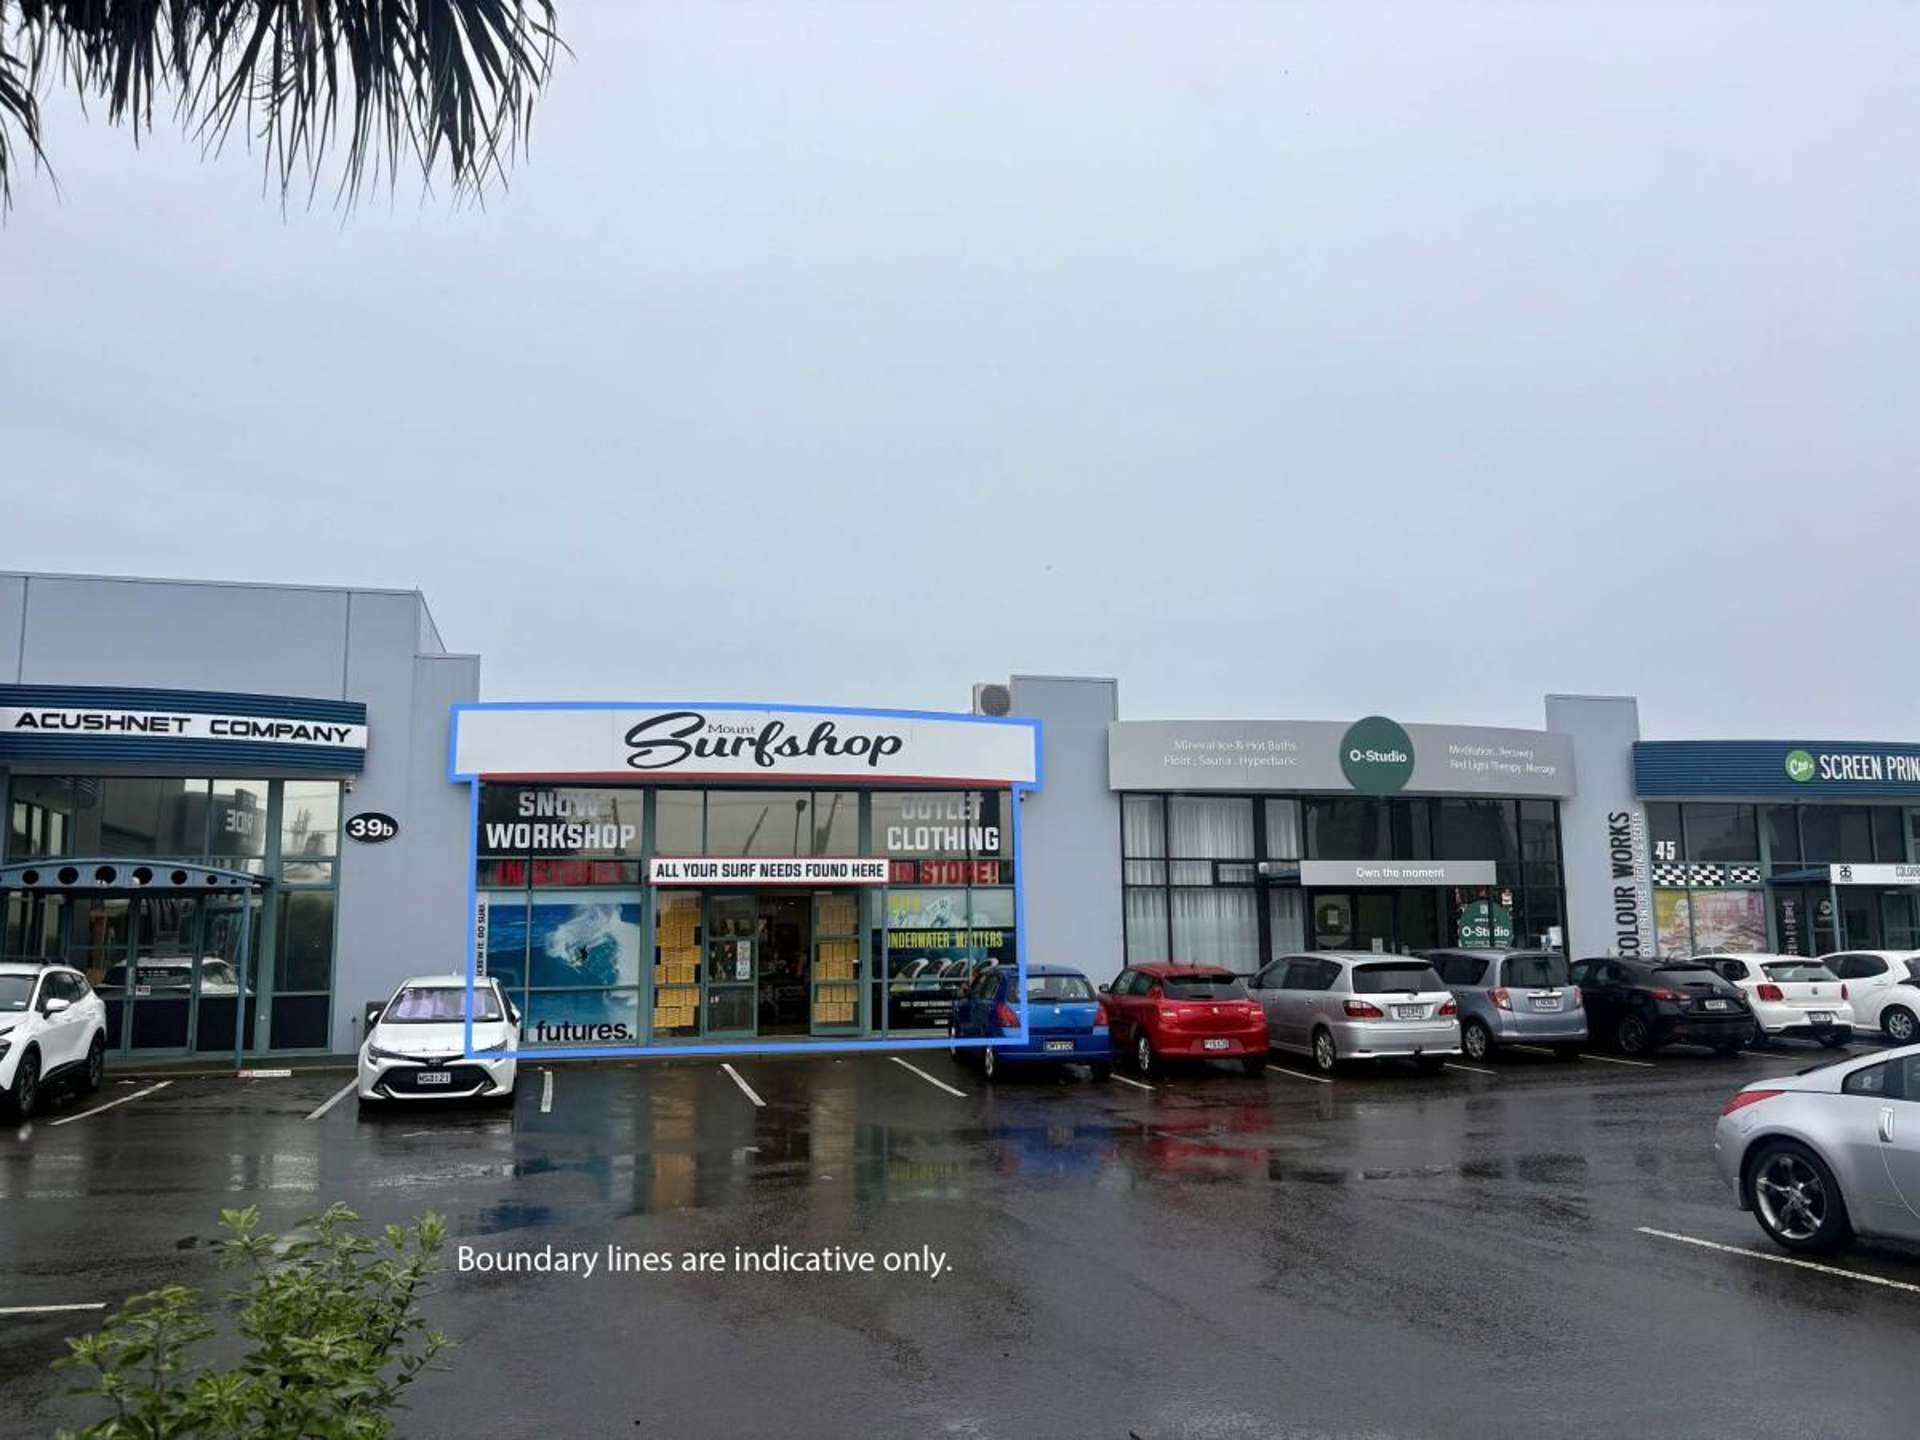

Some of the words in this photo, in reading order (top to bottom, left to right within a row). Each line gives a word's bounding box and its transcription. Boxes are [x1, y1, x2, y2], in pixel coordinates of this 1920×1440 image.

[15, 711, 192, 734] ACUSHNET
[209, 719, 353, 743] COMPANY
[707, 723, 756, 735] Mount
[624, 711, 904, 769] Surfshop
[1349, 749, 1408, 763] O-Studio
[1820, 754, 1882, 780] SCREEN
[1886, 755, 1920, 782] PRIN
[518, 791, 599, 817] SNOW
[349, 817, 394, 838] 39b
[485, 823, 637, 849] WORKSHOP
[887, 826, 999, 851] CLOTHING
[1608, 812, 1634, 879] WORKS
[1655, 841, 1676, 860] 45
[656, 862, 679, 878] ALL
[683, 862, 718, 878] YOUR
[722, 862, 756, 878] SURF
[759, 862, 801, 878] NEEDS
[805, 862, 848, 878] FOUND
[851, 862, 884, 878] HERE
[921, 860, 1000, 885] STORE!
[1356, 867, 1380, 878] Own
[1382, 867, 1399, 878] the
[1402, 868, 1446, 878] moment
[1614, 886, 1640, 960] COLOUR
[535, 1019, 634, 1042] futures.
